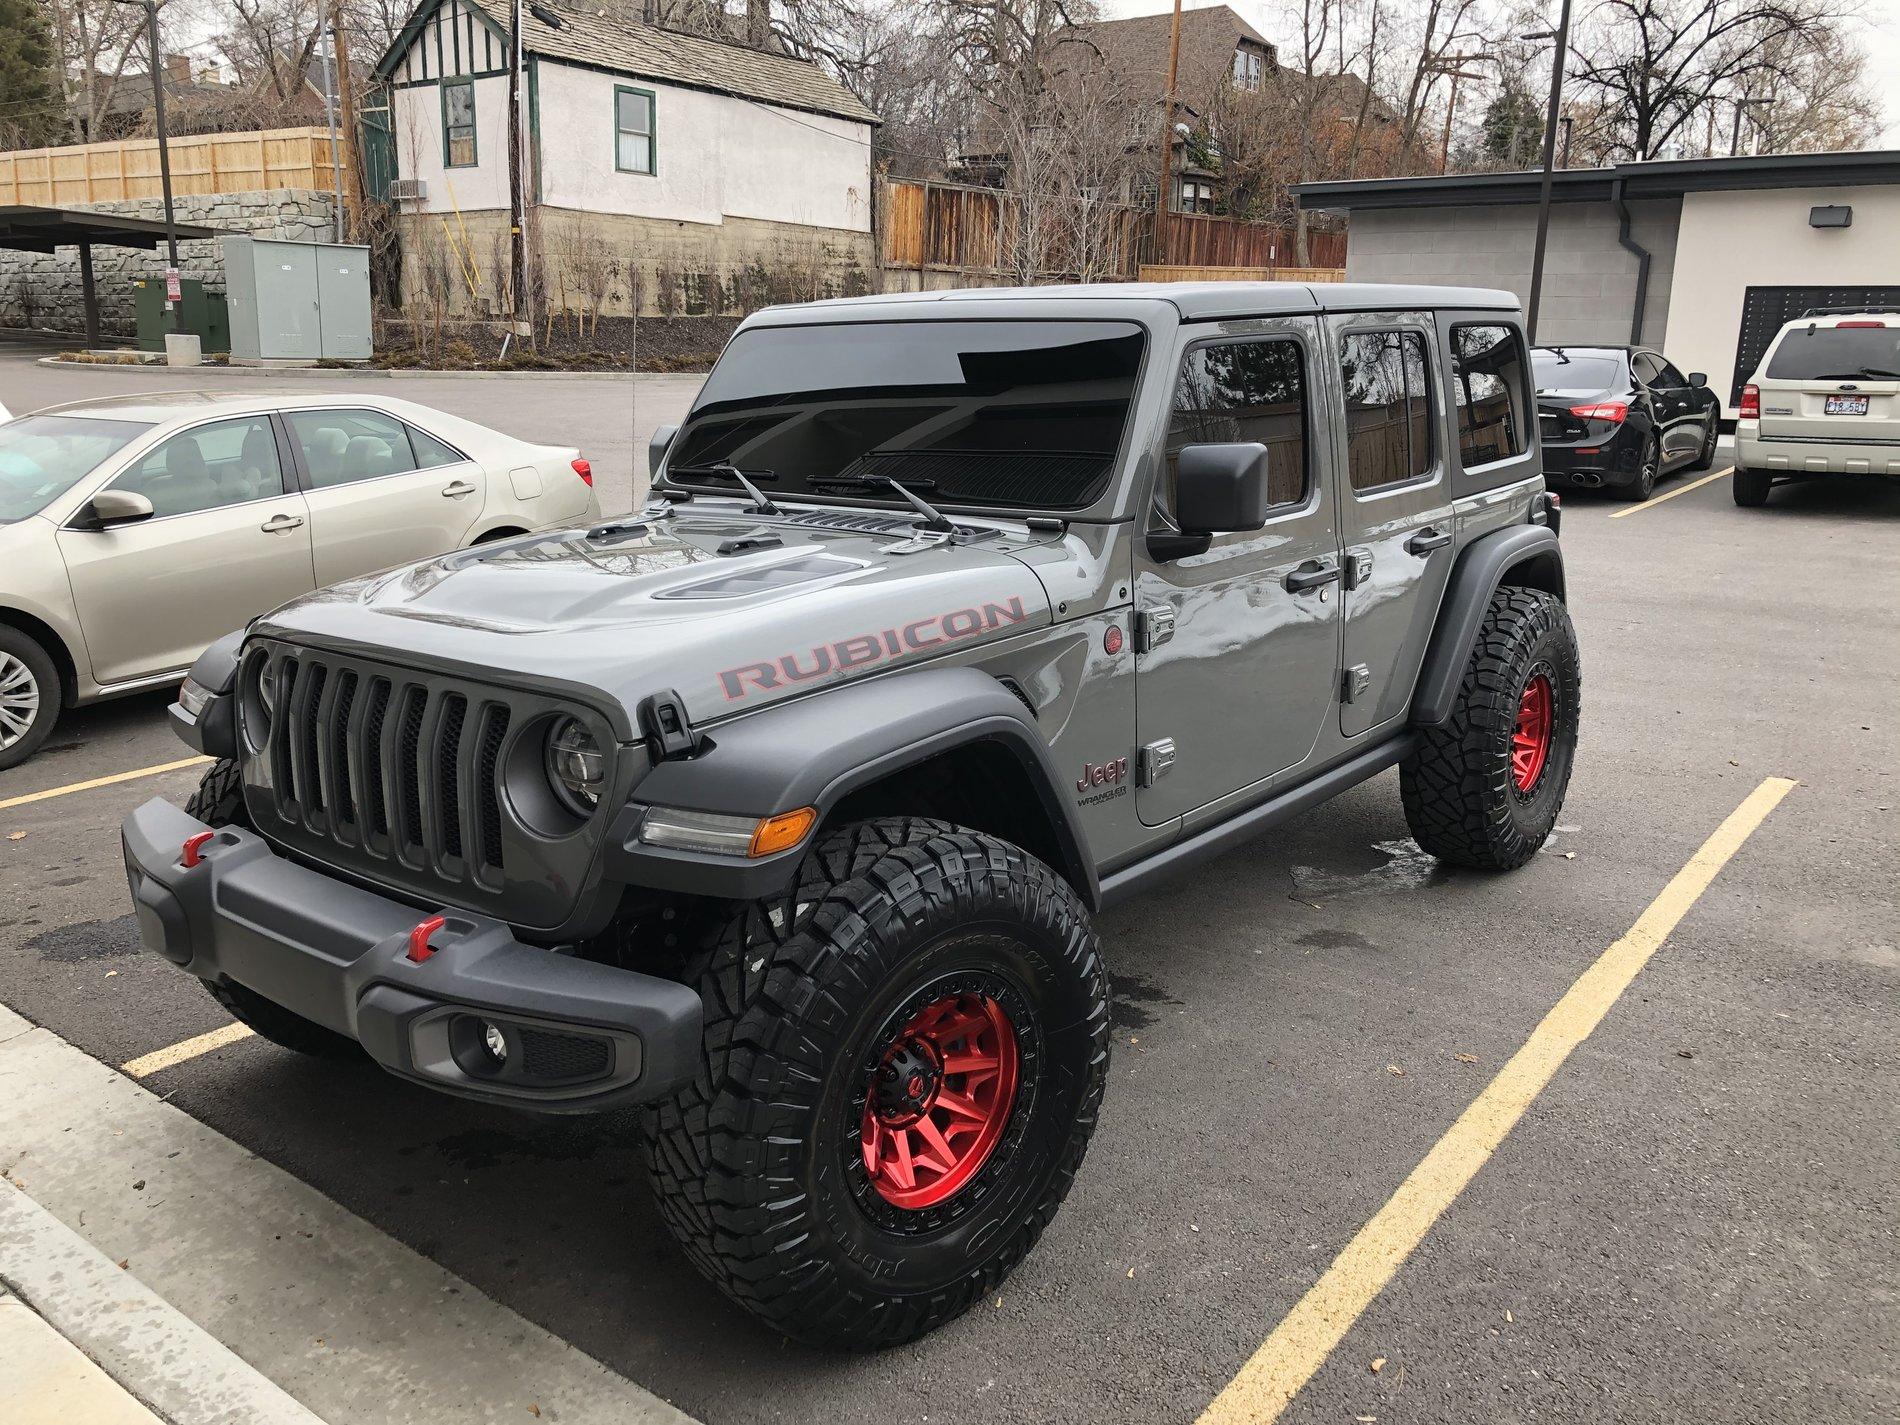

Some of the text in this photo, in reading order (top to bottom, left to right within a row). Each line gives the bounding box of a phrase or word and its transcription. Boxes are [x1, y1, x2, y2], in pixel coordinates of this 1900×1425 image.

[717, 596, 1025, 701] RUBICON
[1077, 757, 1127, 792] Jeep
[1077, 785, 1127, 807] WRANGLER
